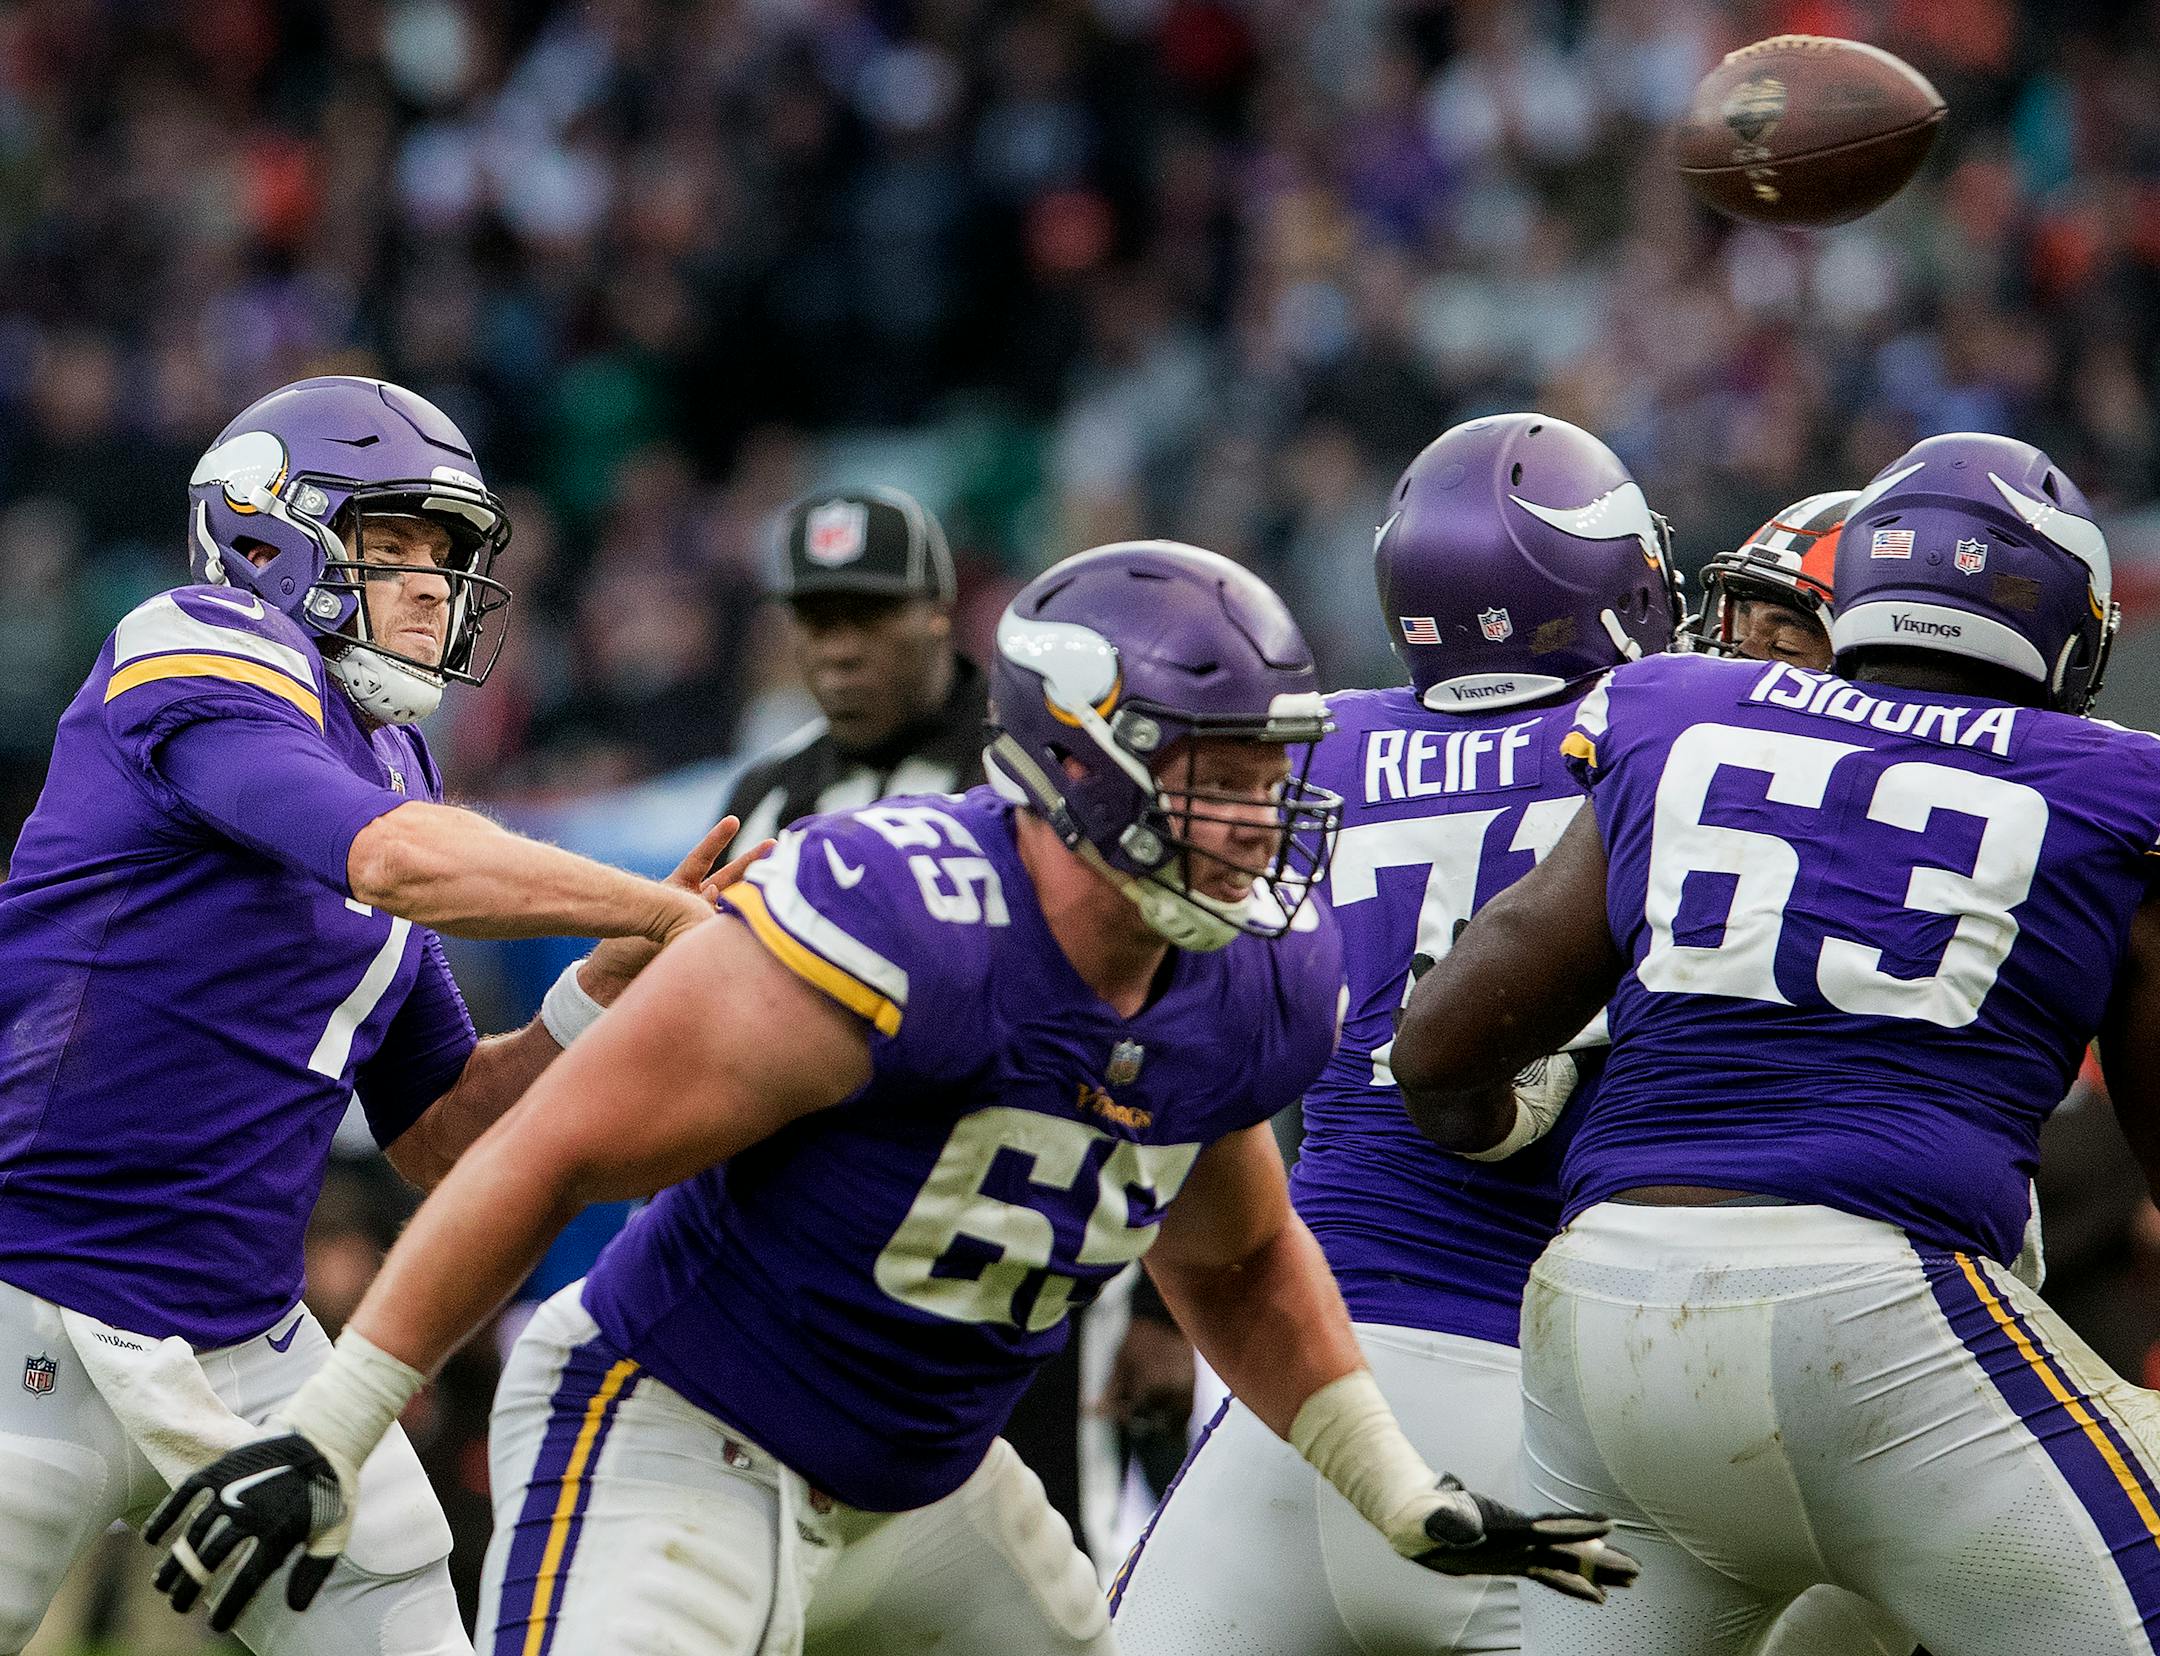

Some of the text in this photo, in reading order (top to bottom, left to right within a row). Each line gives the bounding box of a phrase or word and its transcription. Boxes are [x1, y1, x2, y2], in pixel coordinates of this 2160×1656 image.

[852, 806, 1011, 927] 65
[1365, 717, 1543, 802] REIFF
[1326, 795, 1588, 1086] 7
[1637, 722, 2050, 1028] 63
[873, 1106, 1201, 1332] 65
